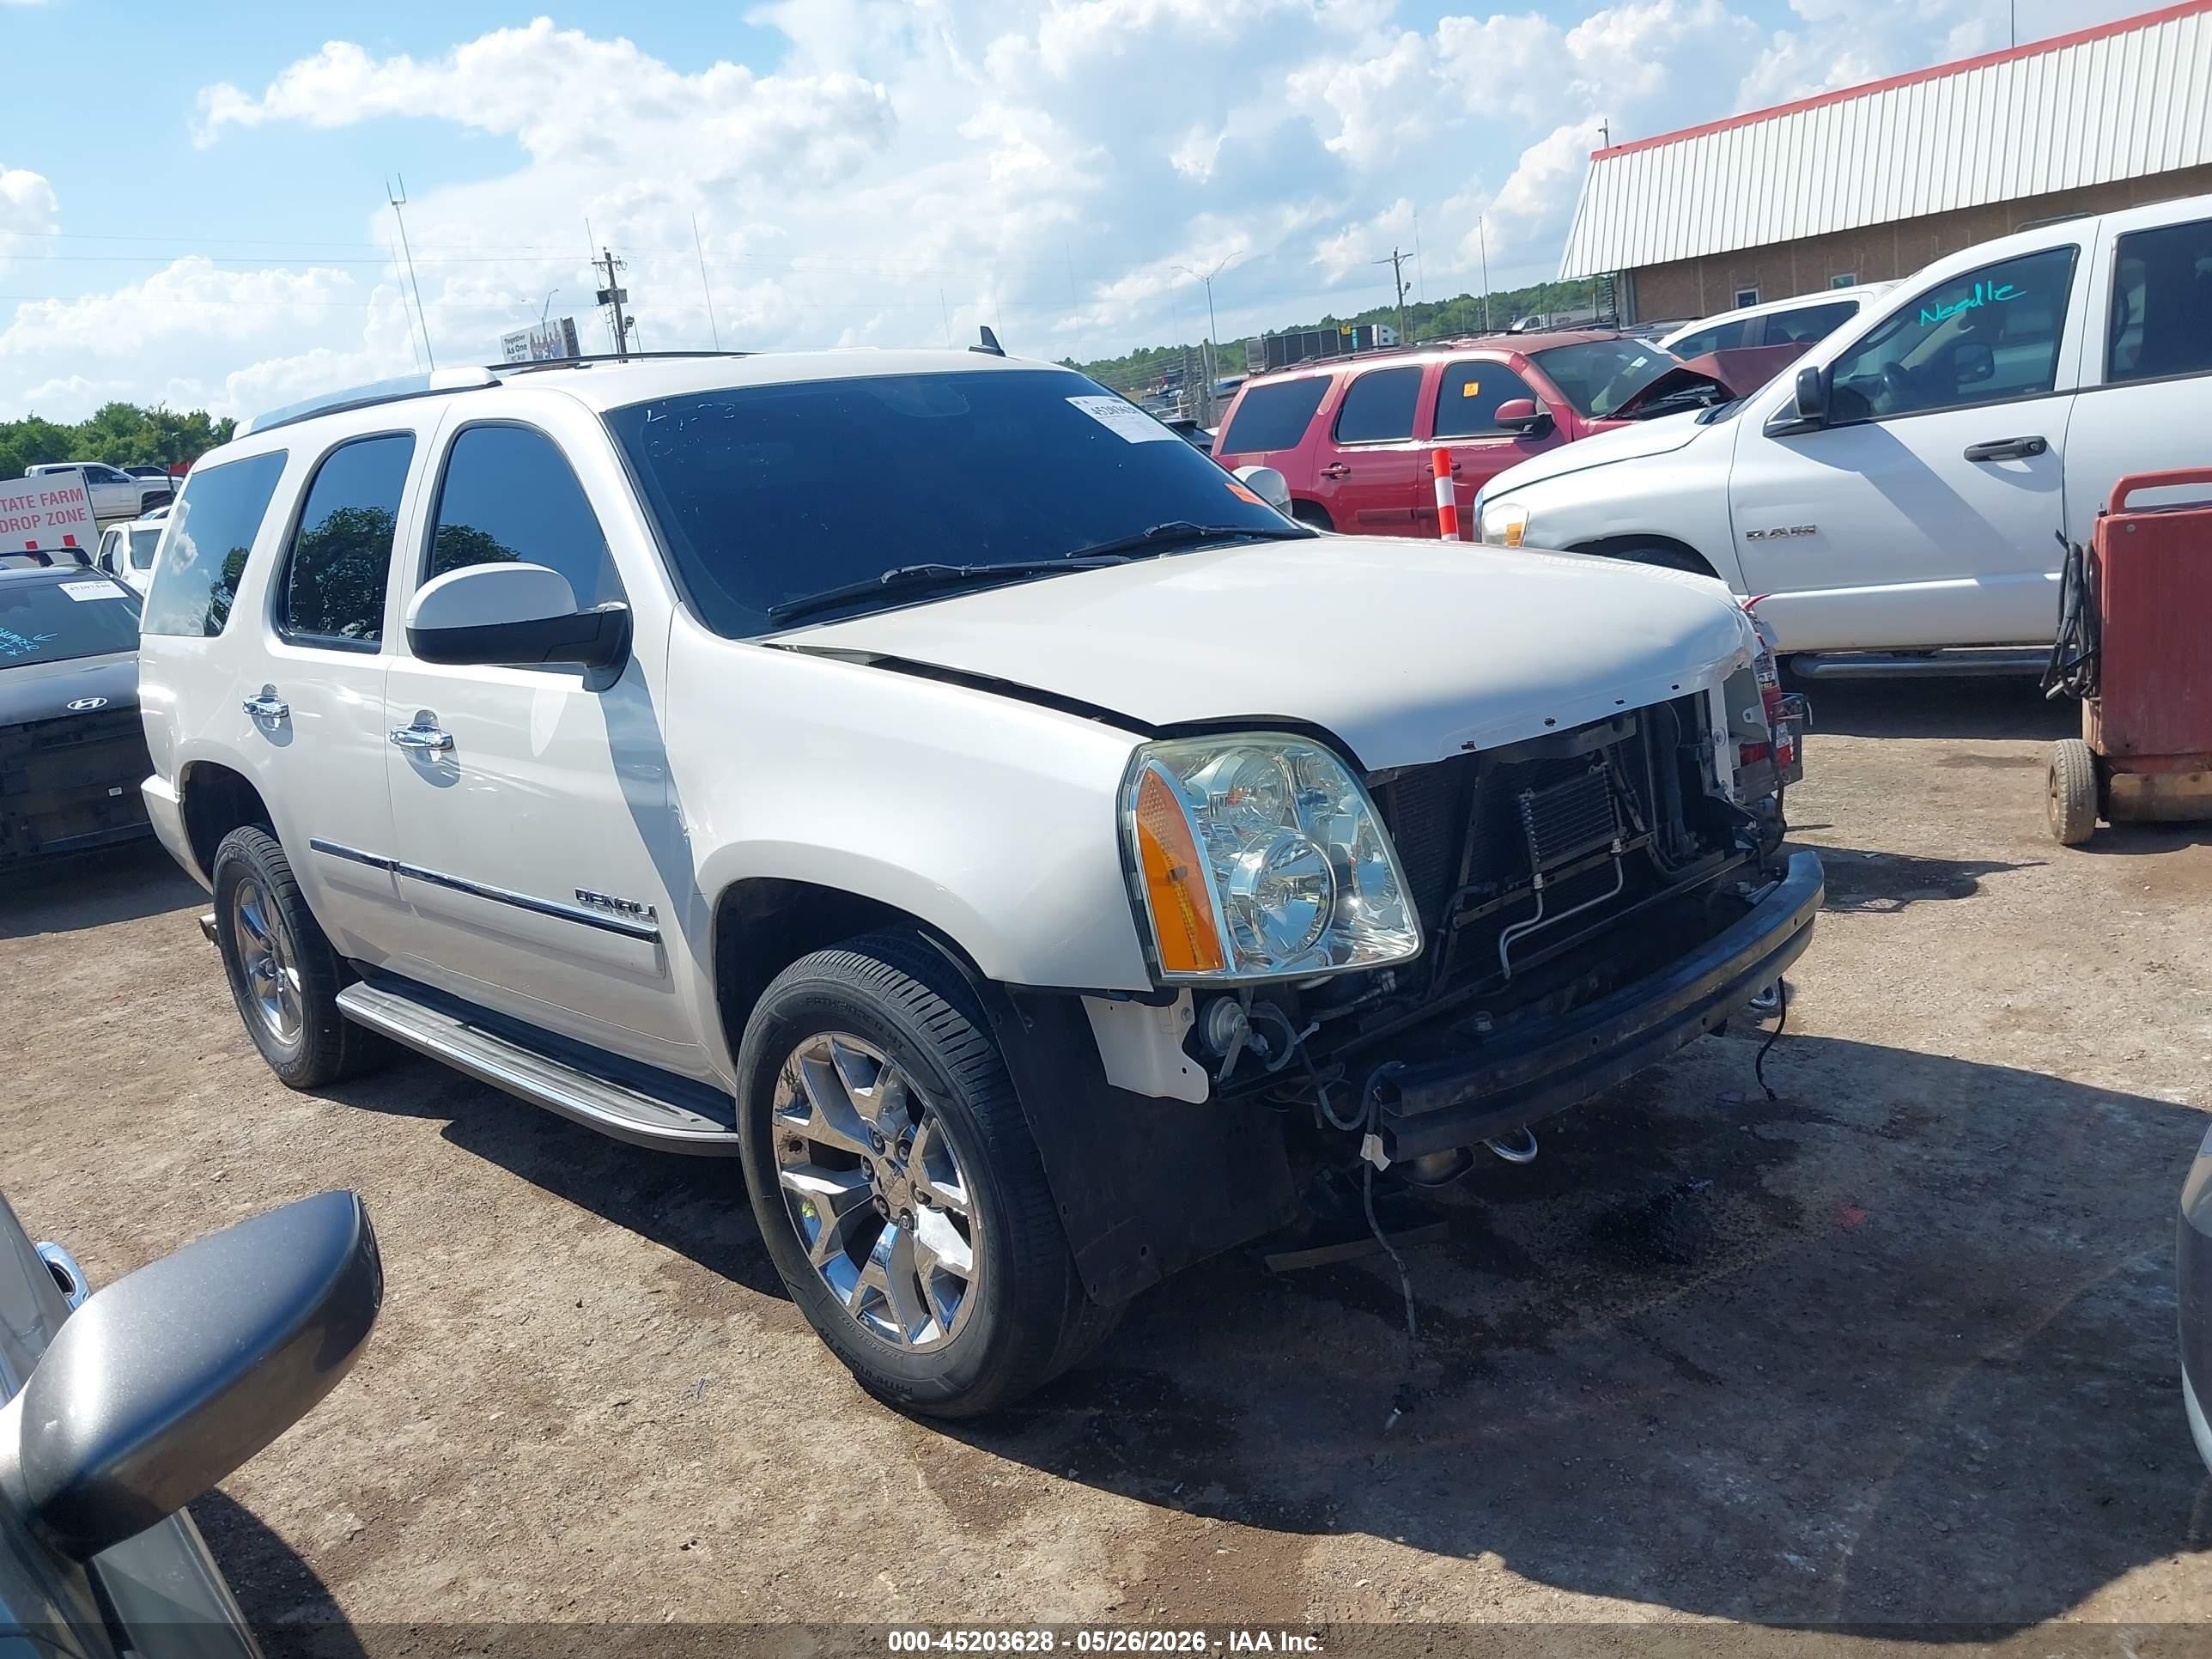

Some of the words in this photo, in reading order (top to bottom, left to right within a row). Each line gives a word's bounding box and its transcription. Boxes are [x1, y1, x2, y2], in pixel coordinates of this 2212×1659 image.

[1920, 280, 2027, 327] Needle
[507, 347, 515, 356] As
[515, 343, 528, 353] One
[0, 495, 36, 513] TATE
[40, 487, 84, 507] FARM
[0, 514, 41, 534] DROP
[46, 507, 88, 526] ZONE
[1745, 524, 1816, 541] RAM
[574, 887, 659, 925] DENALI
